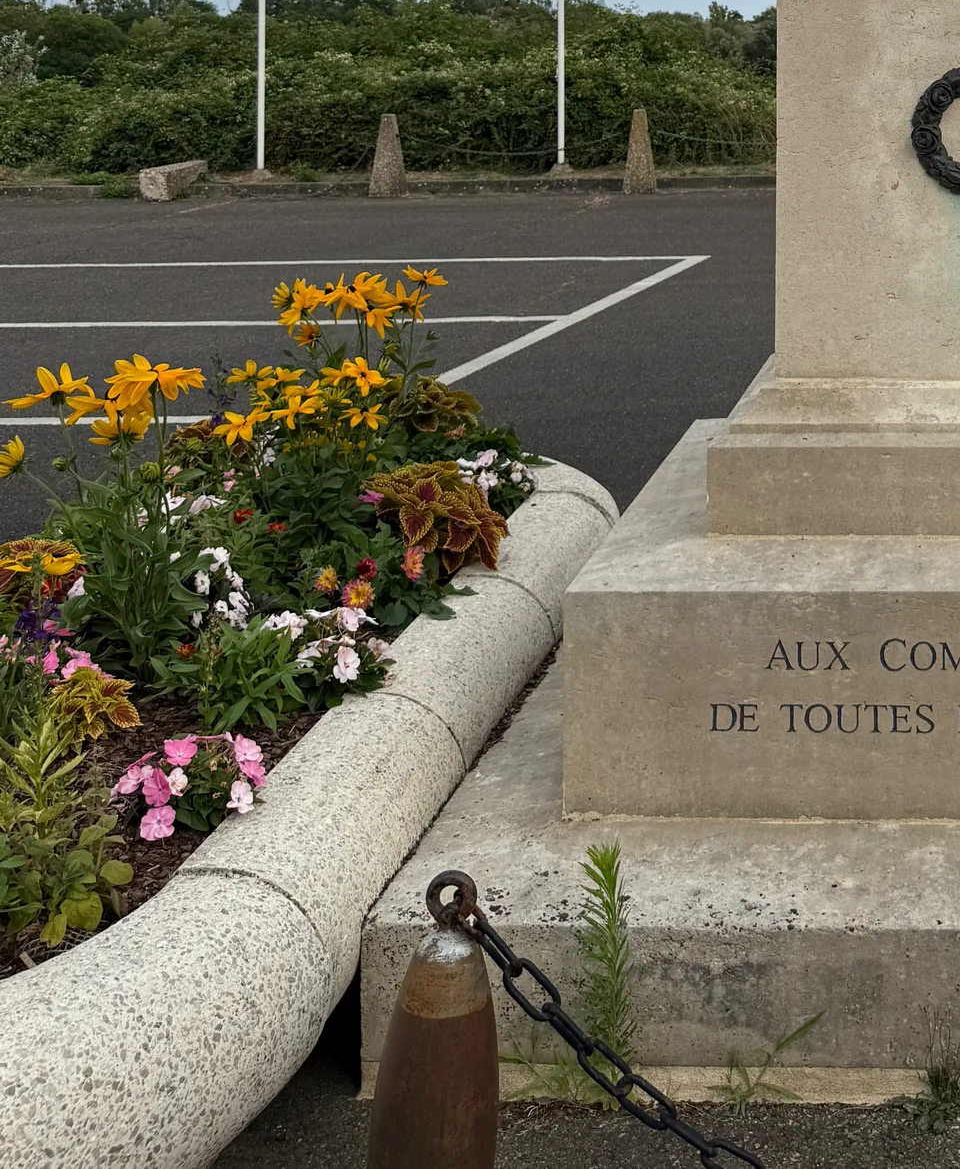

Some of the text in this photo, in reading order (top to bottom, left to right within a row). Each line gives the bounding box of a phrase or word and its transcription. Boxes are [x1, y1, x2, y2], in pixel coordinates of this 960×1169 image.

[764, 638, 851, 672] AUX
[709, 703, 759, 734] DE
[779, 703, 935, 735] TOUTES
